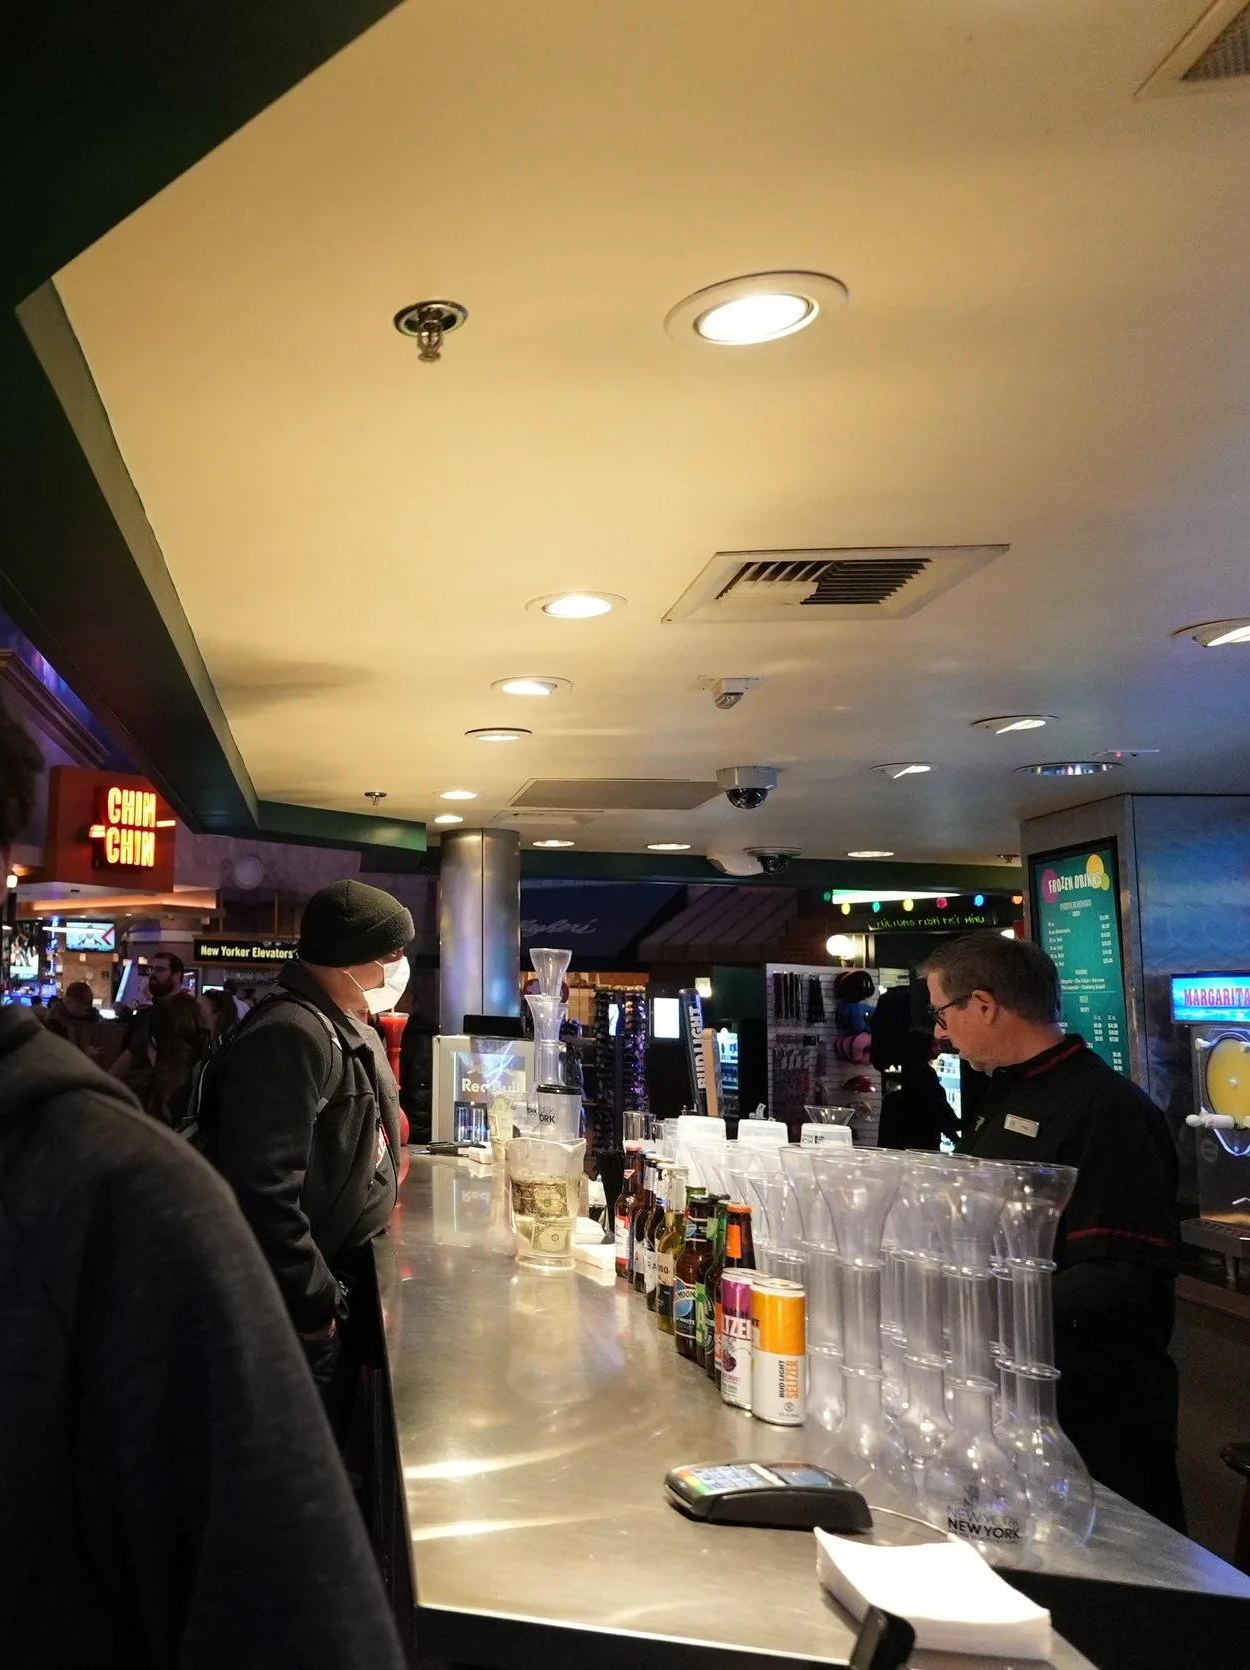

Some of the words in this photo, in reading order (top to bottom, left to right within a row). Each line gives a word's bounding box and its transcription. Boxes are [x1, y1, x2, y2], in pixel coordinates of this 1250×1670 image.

[107, 786, 156, 828] CHIN
[106, 827, 155, 867] CHIN
[1048, 875, 1074, 894] FROZEN
[1074, 871, 1102, 890] DRINKS
[200, 945, 219, 956] New
[221, 946, 250, 957] Yorker
[252, 947, 293, 959] Elevators
[539, 1113, 556, 1124] ORK
[786, 1360, 798, 1399] SELTZER
[948, 1517, 982, 1535] NEW
[983, 1525, 1023, 1540] YORK
